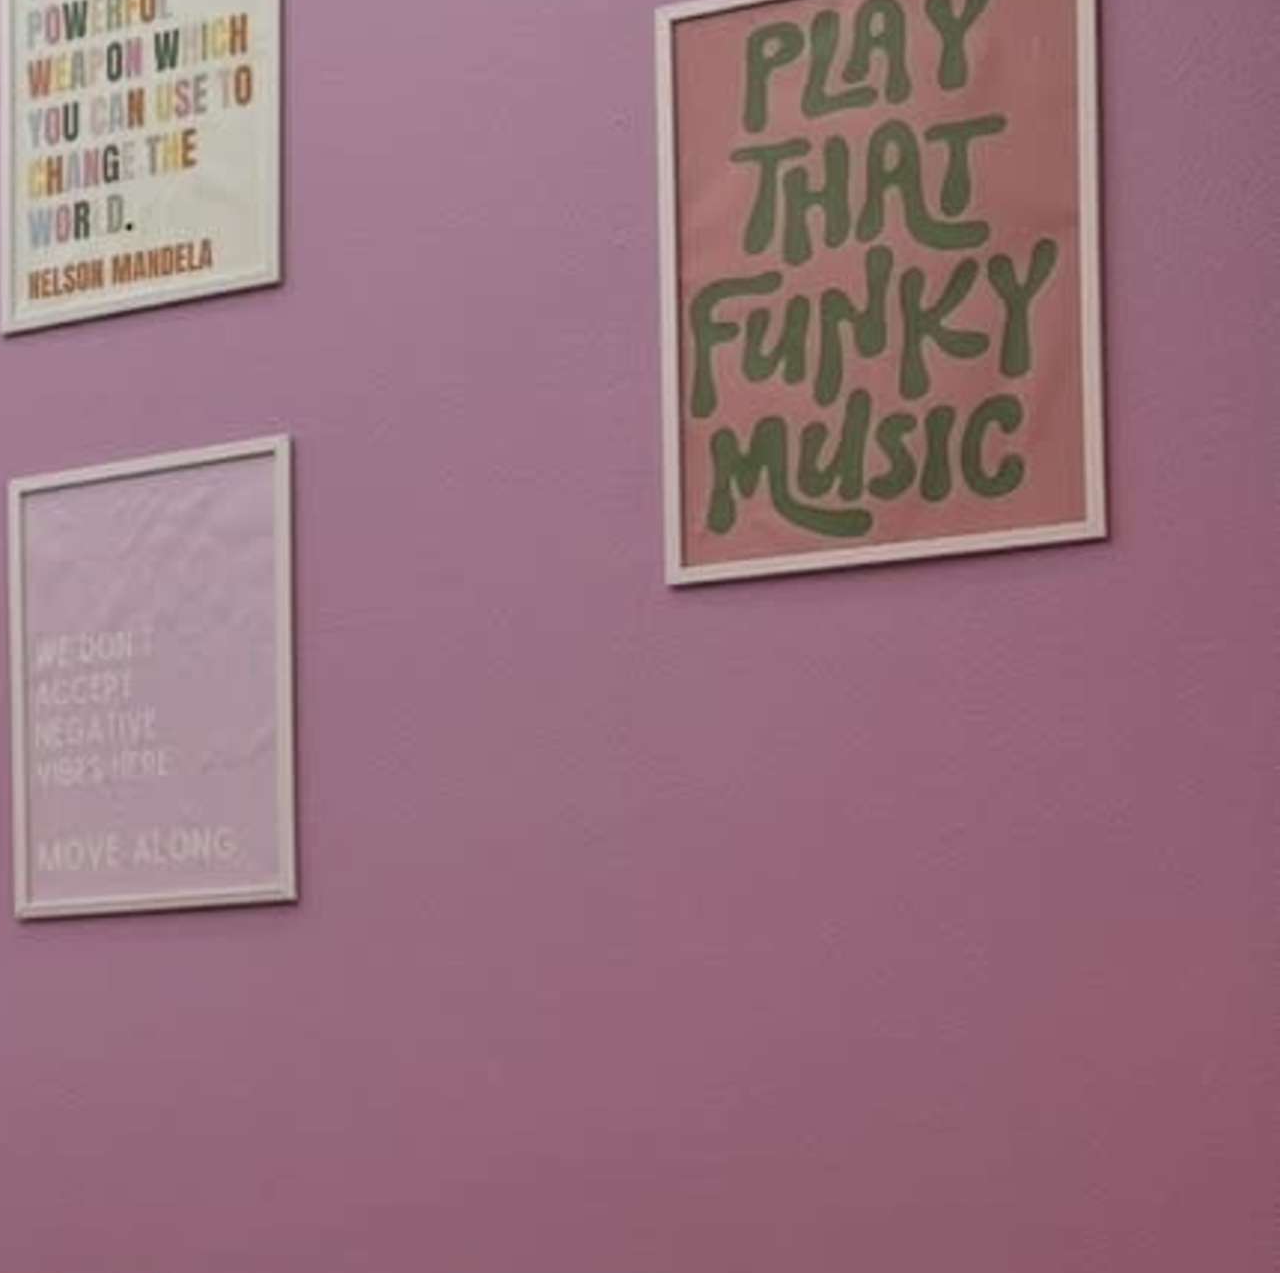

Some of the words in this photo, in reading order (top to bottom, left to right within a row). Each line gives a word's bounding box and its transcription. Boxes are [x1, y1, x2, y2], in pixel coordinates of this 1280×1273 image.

[27, 37, 143, 99] WEAPON
[153, 13, 248, 72] WHICH
[27, 101, 79, 148] YOU
[91, 87, 145, 135] CAN
[155, 73, 208, 121] USE
[217, 65, 253, 110] TO
[28, 140, 136, 199] CHANGE
[146, 127, 197, 176] THE
[730, 113, 1007, 266] THAT
[29, 194, 133, 248] WORD.
[29, 259, 105, 300] NELSON
[111, 238, 213, 285] MANDELA
[689, 237, 1059, 419] FUNKY
[705, 388, 1026, 538] MUSIC
[79, 627, 153, 664] DONT
[37, 829, 121, 872] MOVE
